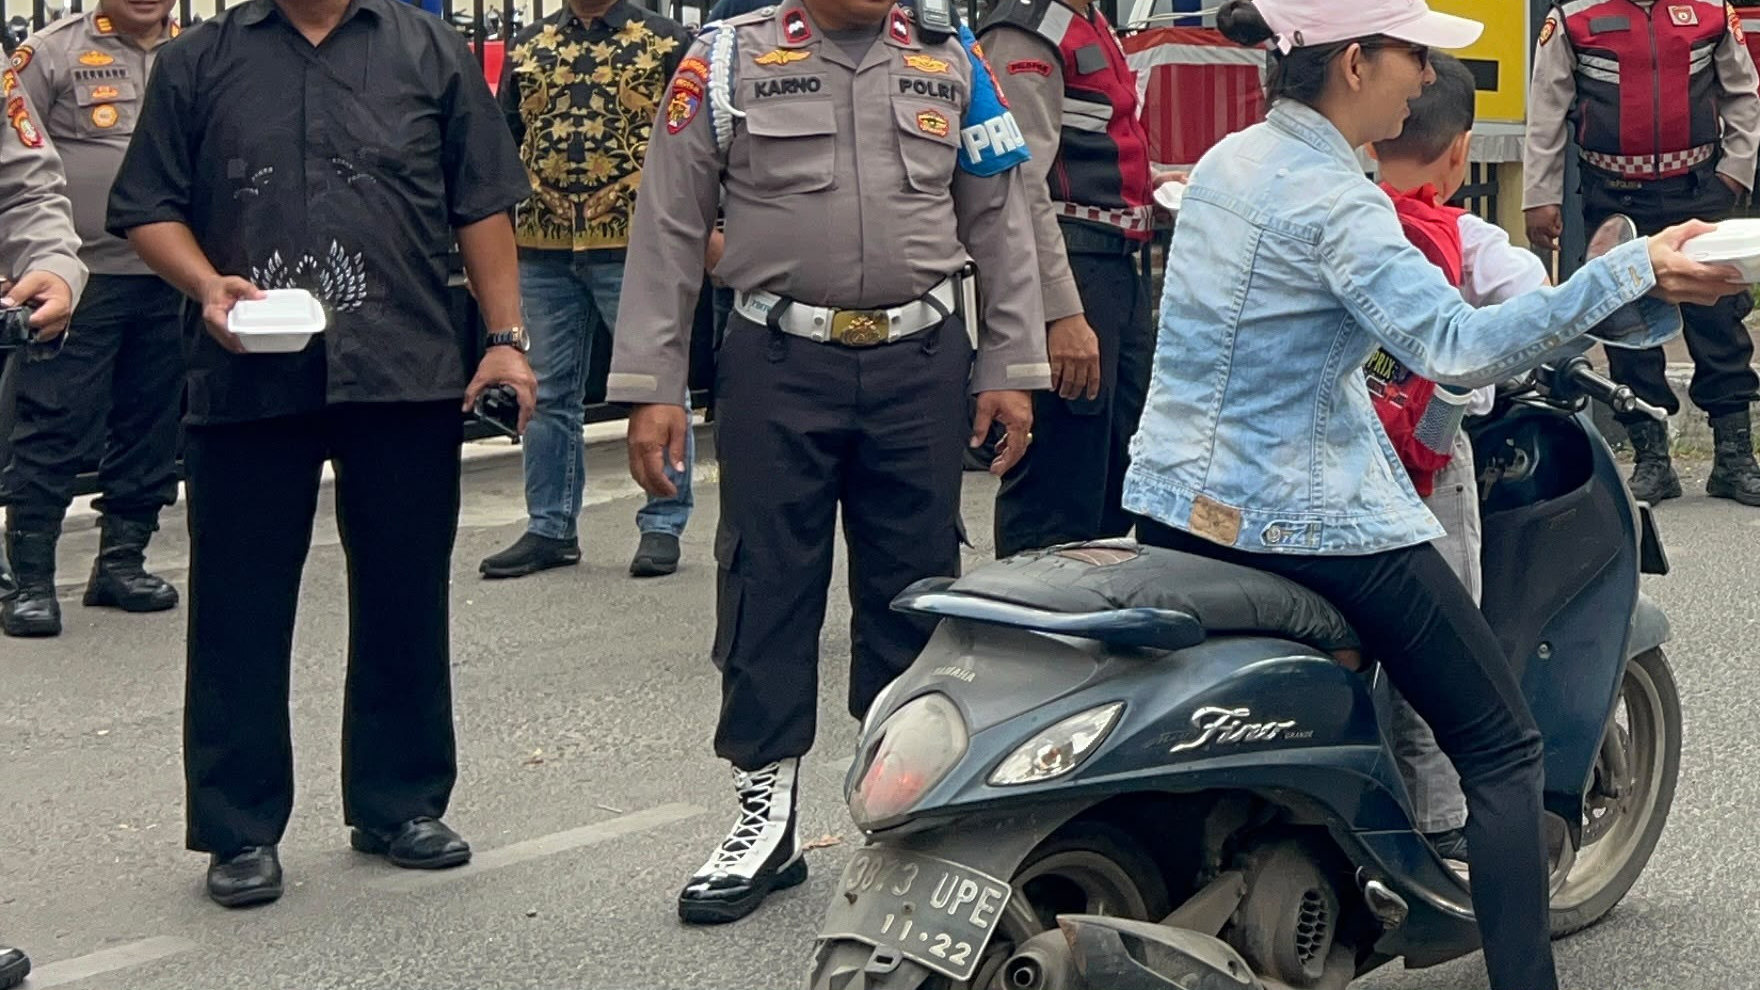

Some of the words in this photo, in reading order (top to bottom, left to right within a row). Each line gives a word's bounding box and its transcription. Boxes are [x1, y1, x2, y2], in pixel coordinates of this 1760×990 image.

[753, 76, 822, 99] KARNO
[899, 78, 957, 102] POLRI
[1170, 706, 1296, 753] Fino
[929, 872, 1003, 929] UPE
